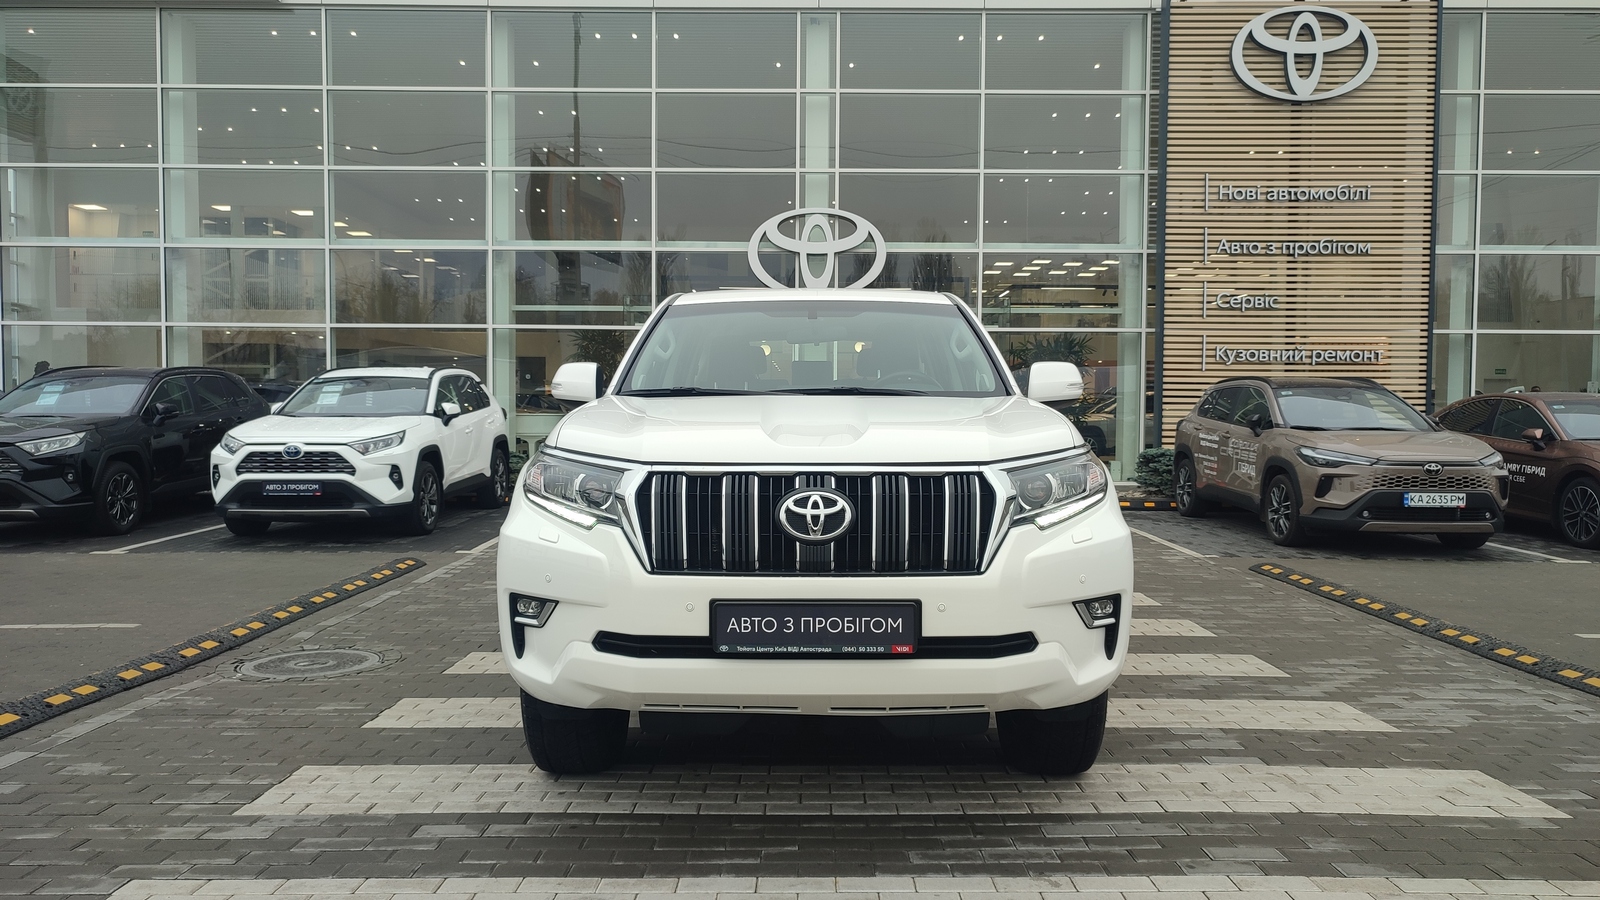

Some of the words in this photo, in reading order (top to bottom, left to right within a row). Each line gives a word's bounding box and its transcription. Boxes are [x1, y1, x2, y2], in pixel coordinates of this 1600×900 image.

[1218, 184, 1261, 201] Нові
[1266, 184, 1372, 202] автомобілі
[1216, 238, 1261, 255] Авто
[1266, 241, 1276, 255] з
[1282, 238, 1371, 258] пробігом
[1216, 292, 1280, 312] Сервіс
[1215, 345, 1306, 365] Кузовний
[1311, 348, 1385, 365] ремонт
[1521, 464, 1546, 478] ГІБРИД
[1425, 494, 1449, 504] 2635
[727, 617, 777, 633] АВТО
[783, 617, 794, 633] З
[801, 617, 902, 633] ПРОБІГОМ
